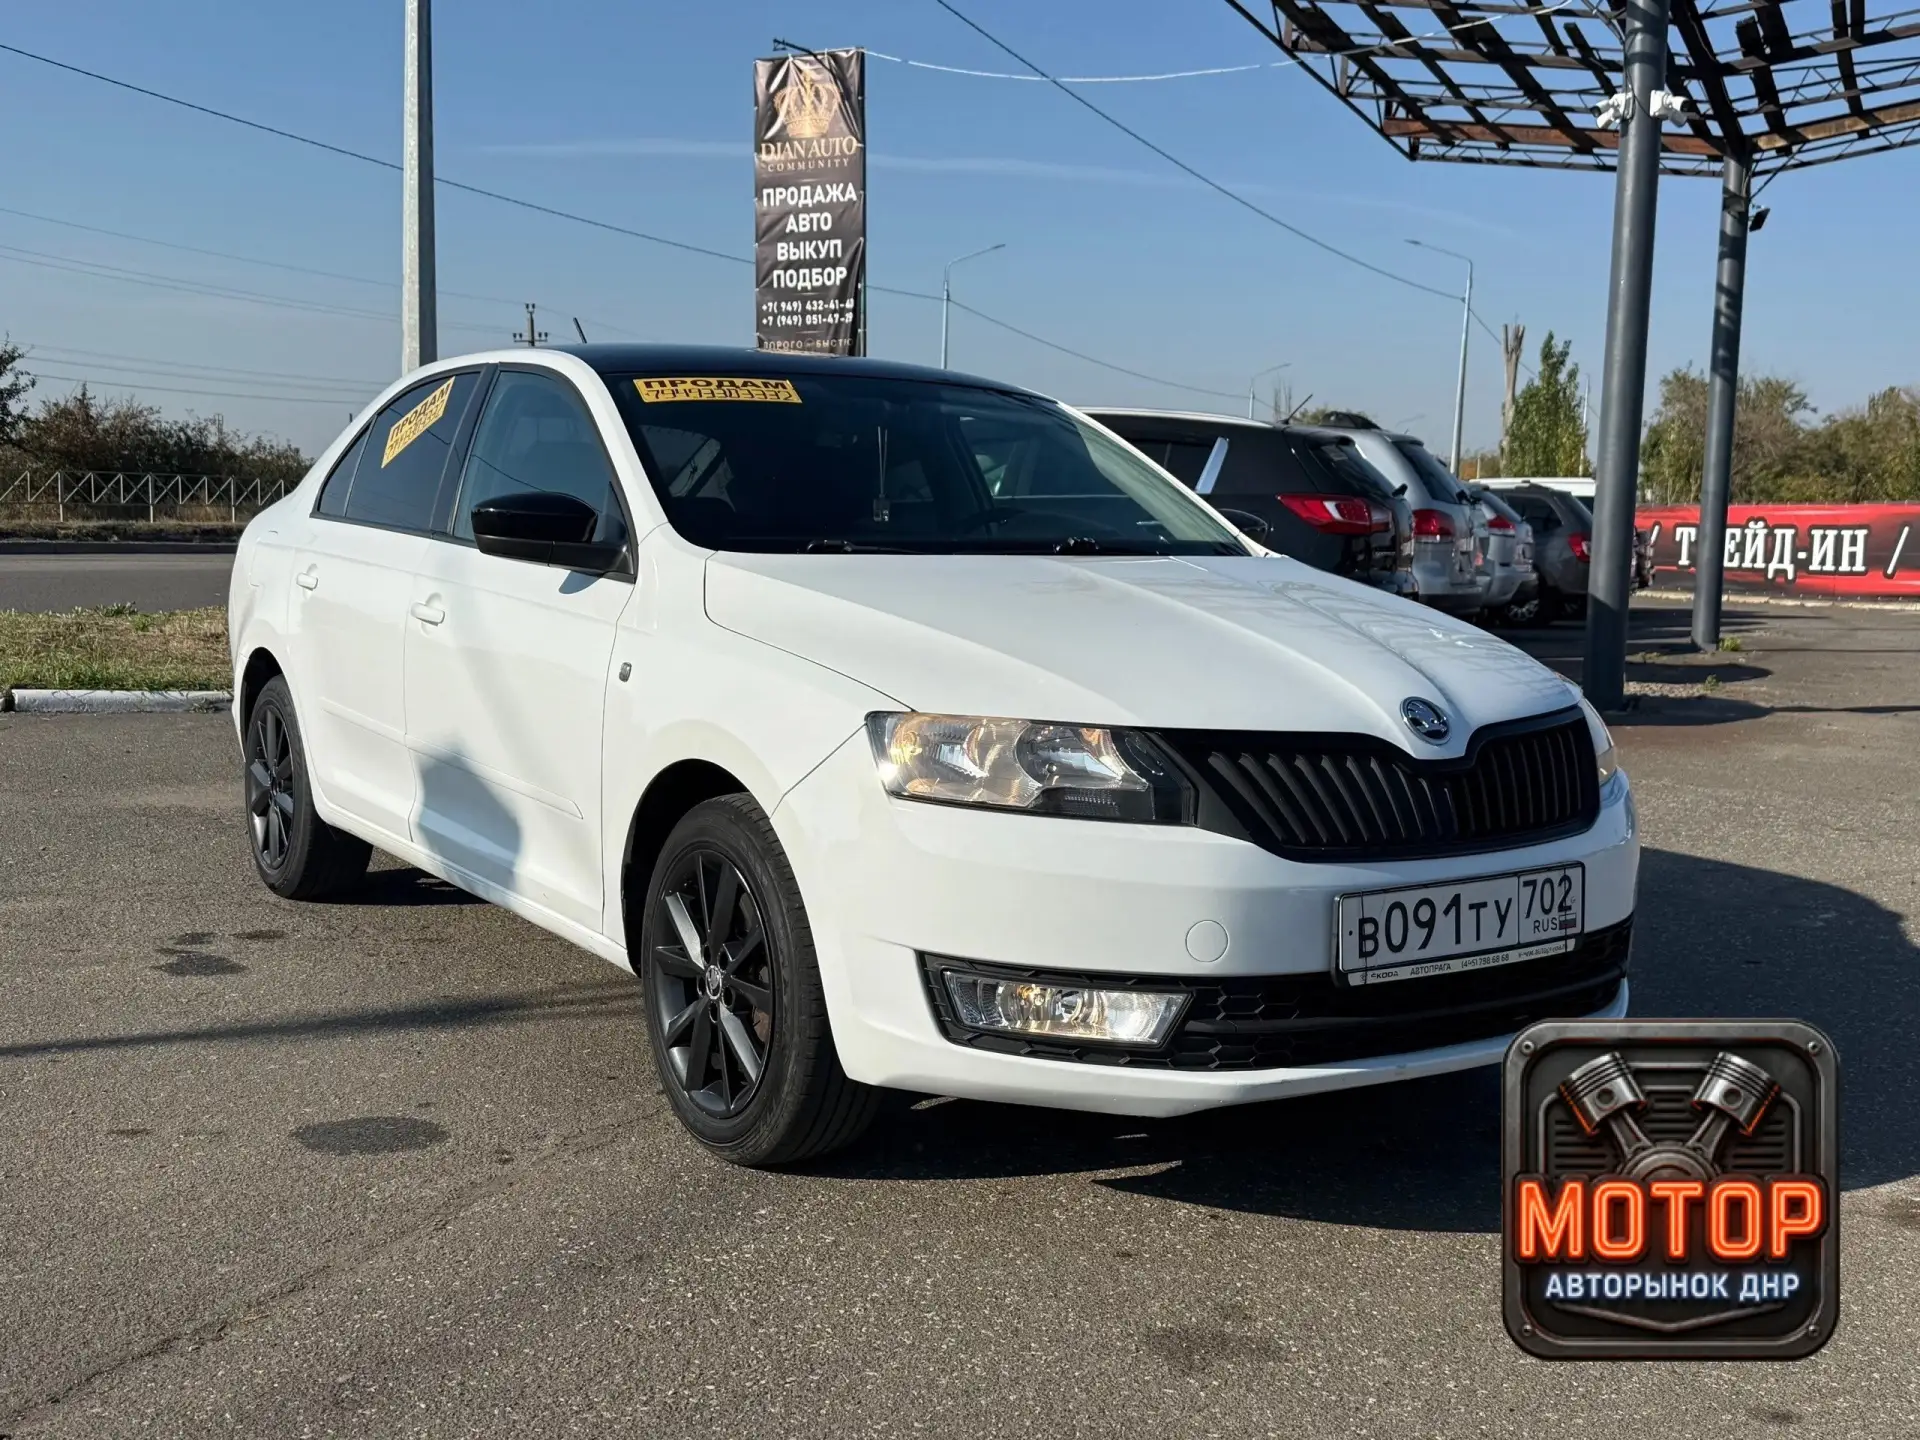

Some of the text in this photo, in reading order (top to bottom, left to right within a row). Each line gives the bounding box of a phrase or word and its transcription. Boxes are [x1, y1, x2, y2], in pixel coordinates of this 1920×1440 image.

[808, 136, 857, 157] AUTO
[767, 158, 850, 172] COMMUNITY
[762, 182, 857, 208] ПРОДАЖА
[785, 212, 832, 233] АВТО
[776, 239, 842, 261] ВЫКУП
[772, 267, 847, 290] ПОДБОР
[762, 316, 774, 327] +7
[643, 379, 788, 390] ПРОДАМ
[390, 382, 452, 442] ПРОДАМ
[1675, 520, 1868, 580] ТЕЙД-ИН
[1358, 874, 1573, 959] В091ТУ 702
[1533, 917, 1558, 934] RUS
